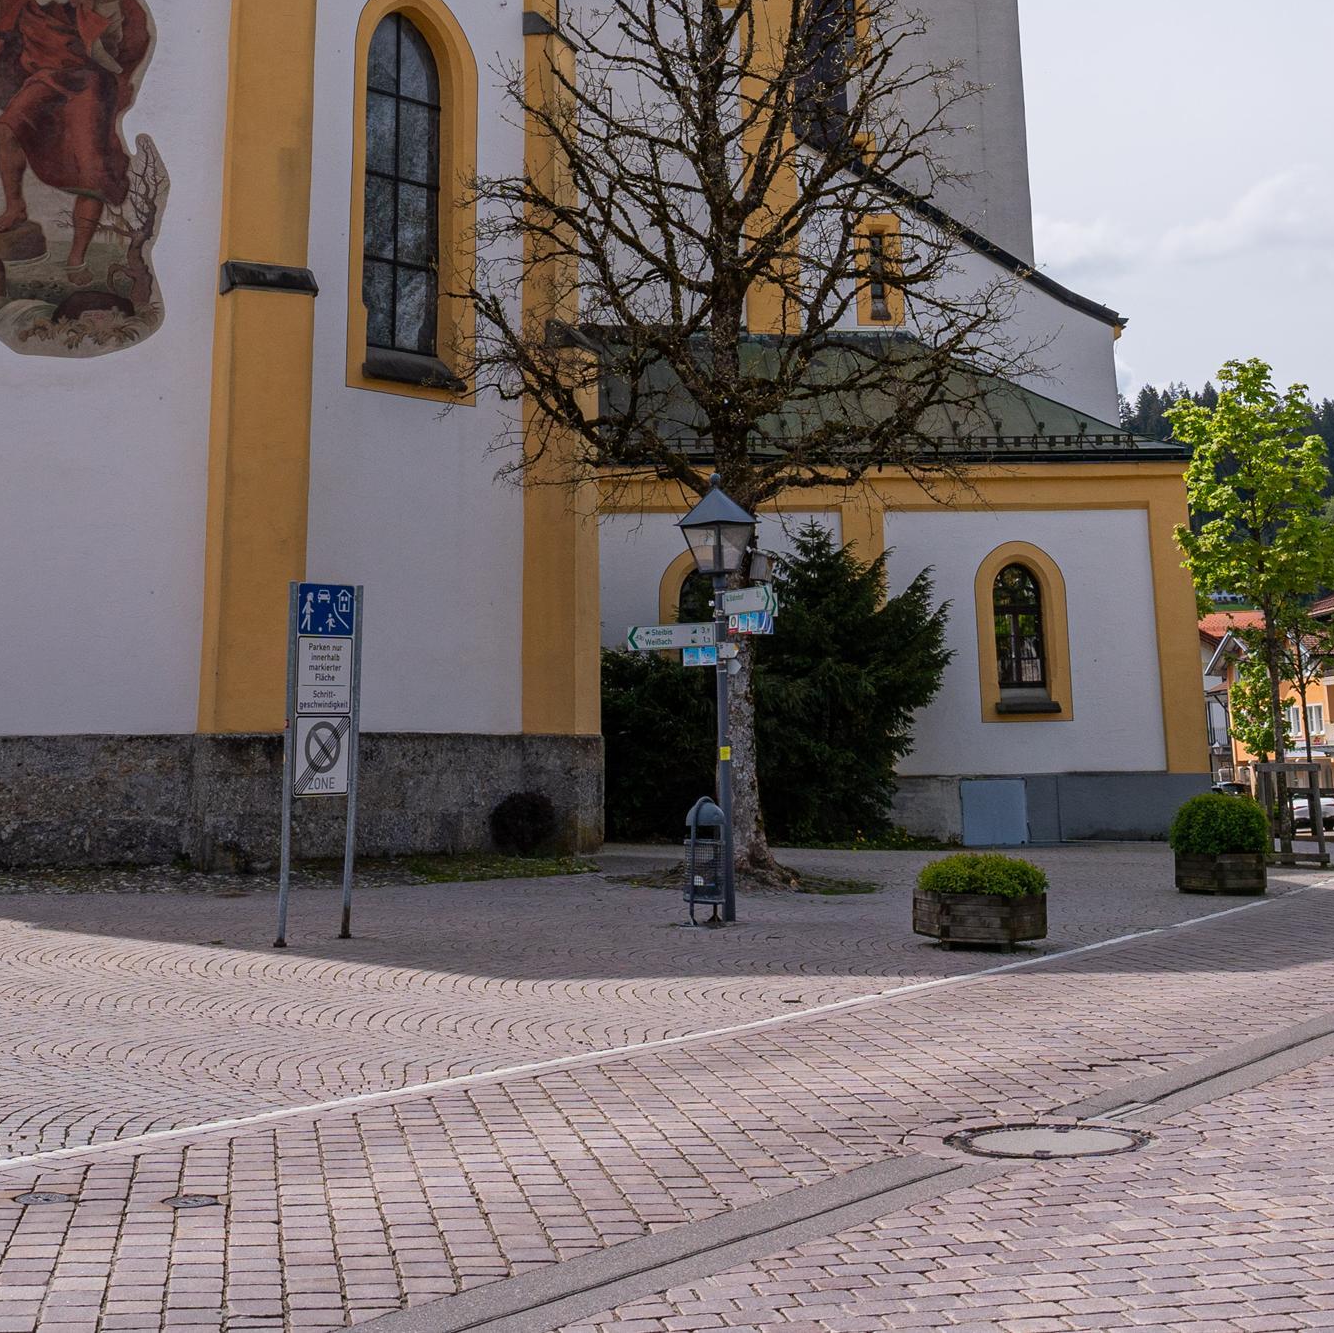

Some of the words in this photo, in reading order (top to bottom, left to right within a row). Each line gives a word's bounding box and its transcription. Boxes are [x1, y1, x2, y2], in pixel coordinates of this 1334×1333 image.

[651, 628, 673, 636] Steibis
[308, 642, 330, 651] Parken
[645, 638, 673, 646] Weißach
[310, 653, 340, 661] innerhalb
[308, 663, 342, 672] markierter
[314, 673, 336, 682] Fläche
[312, 690, 336, 698] Schritt-
[299, 701, 348, 710] geschwindigkeit
[307, 776, 336, 790] ZONE
